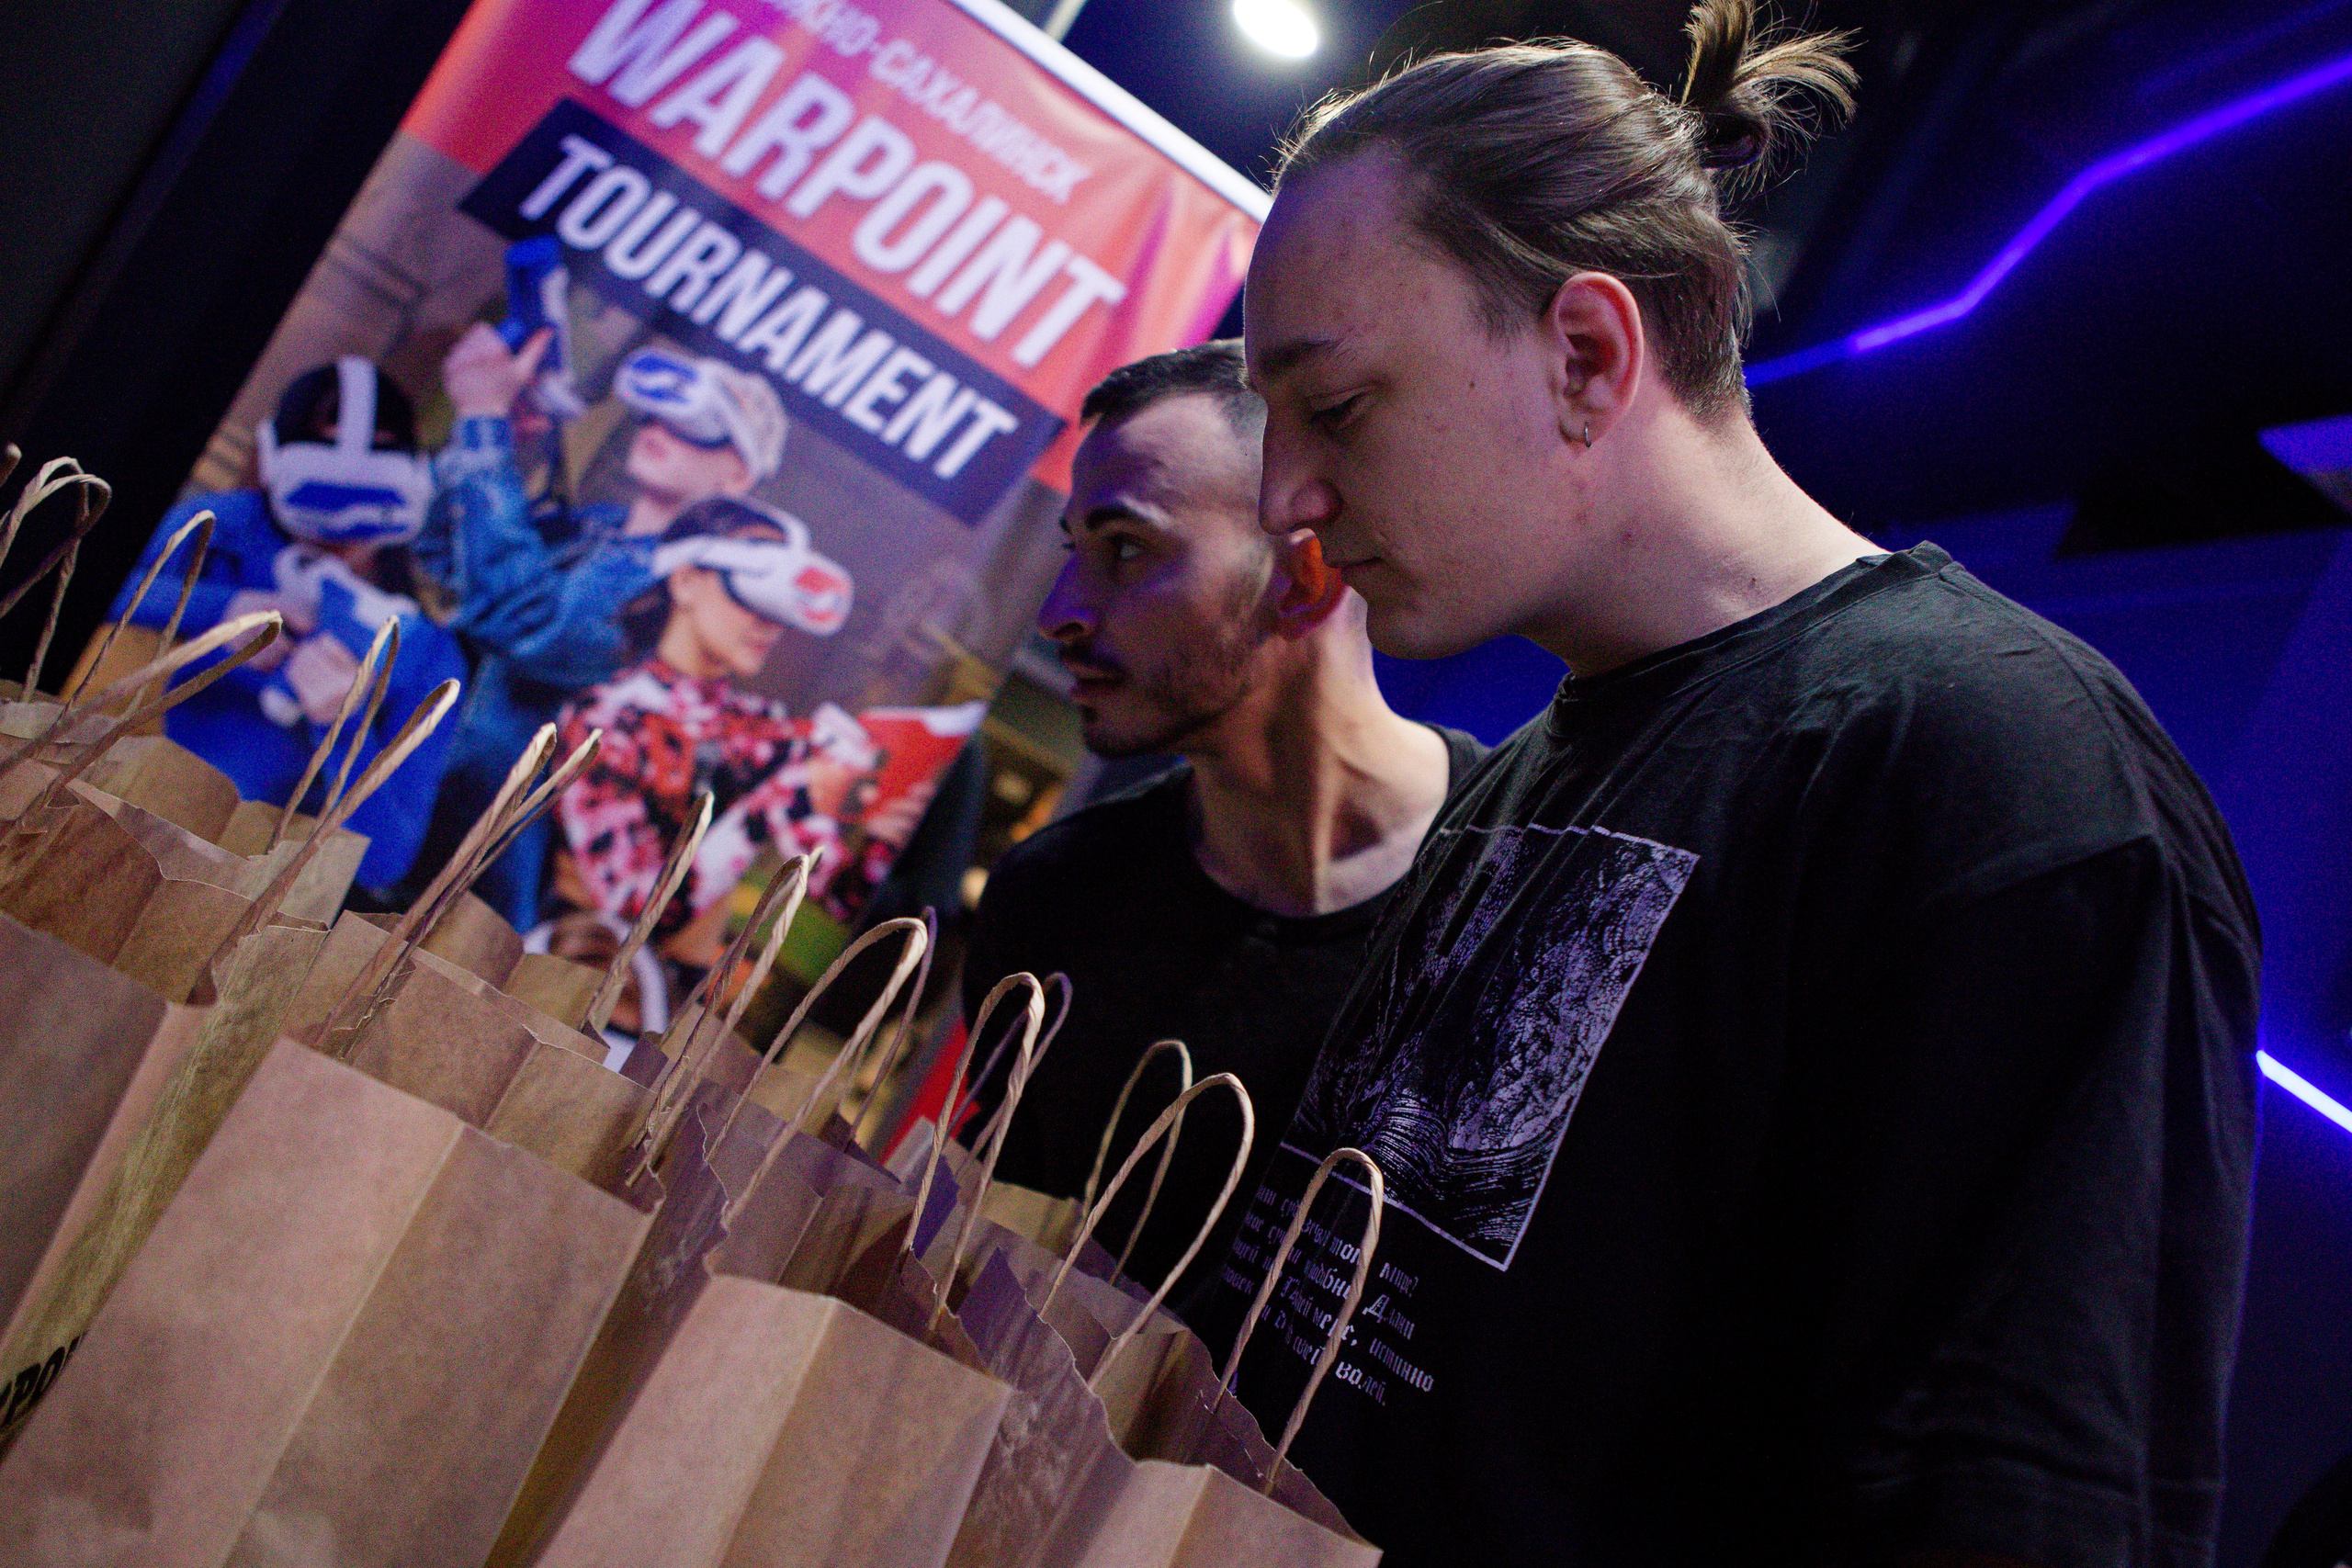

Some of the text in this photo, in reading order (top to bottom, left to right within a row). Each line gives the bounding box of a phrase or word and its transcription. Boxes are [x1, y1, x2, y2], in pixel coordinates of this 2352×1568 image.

[519, 134, 1019, 479] TOURNAMENT
[567, 0, 1125, 367] WARPOINT
[1369, 1337, 1434, 1393] истинно
